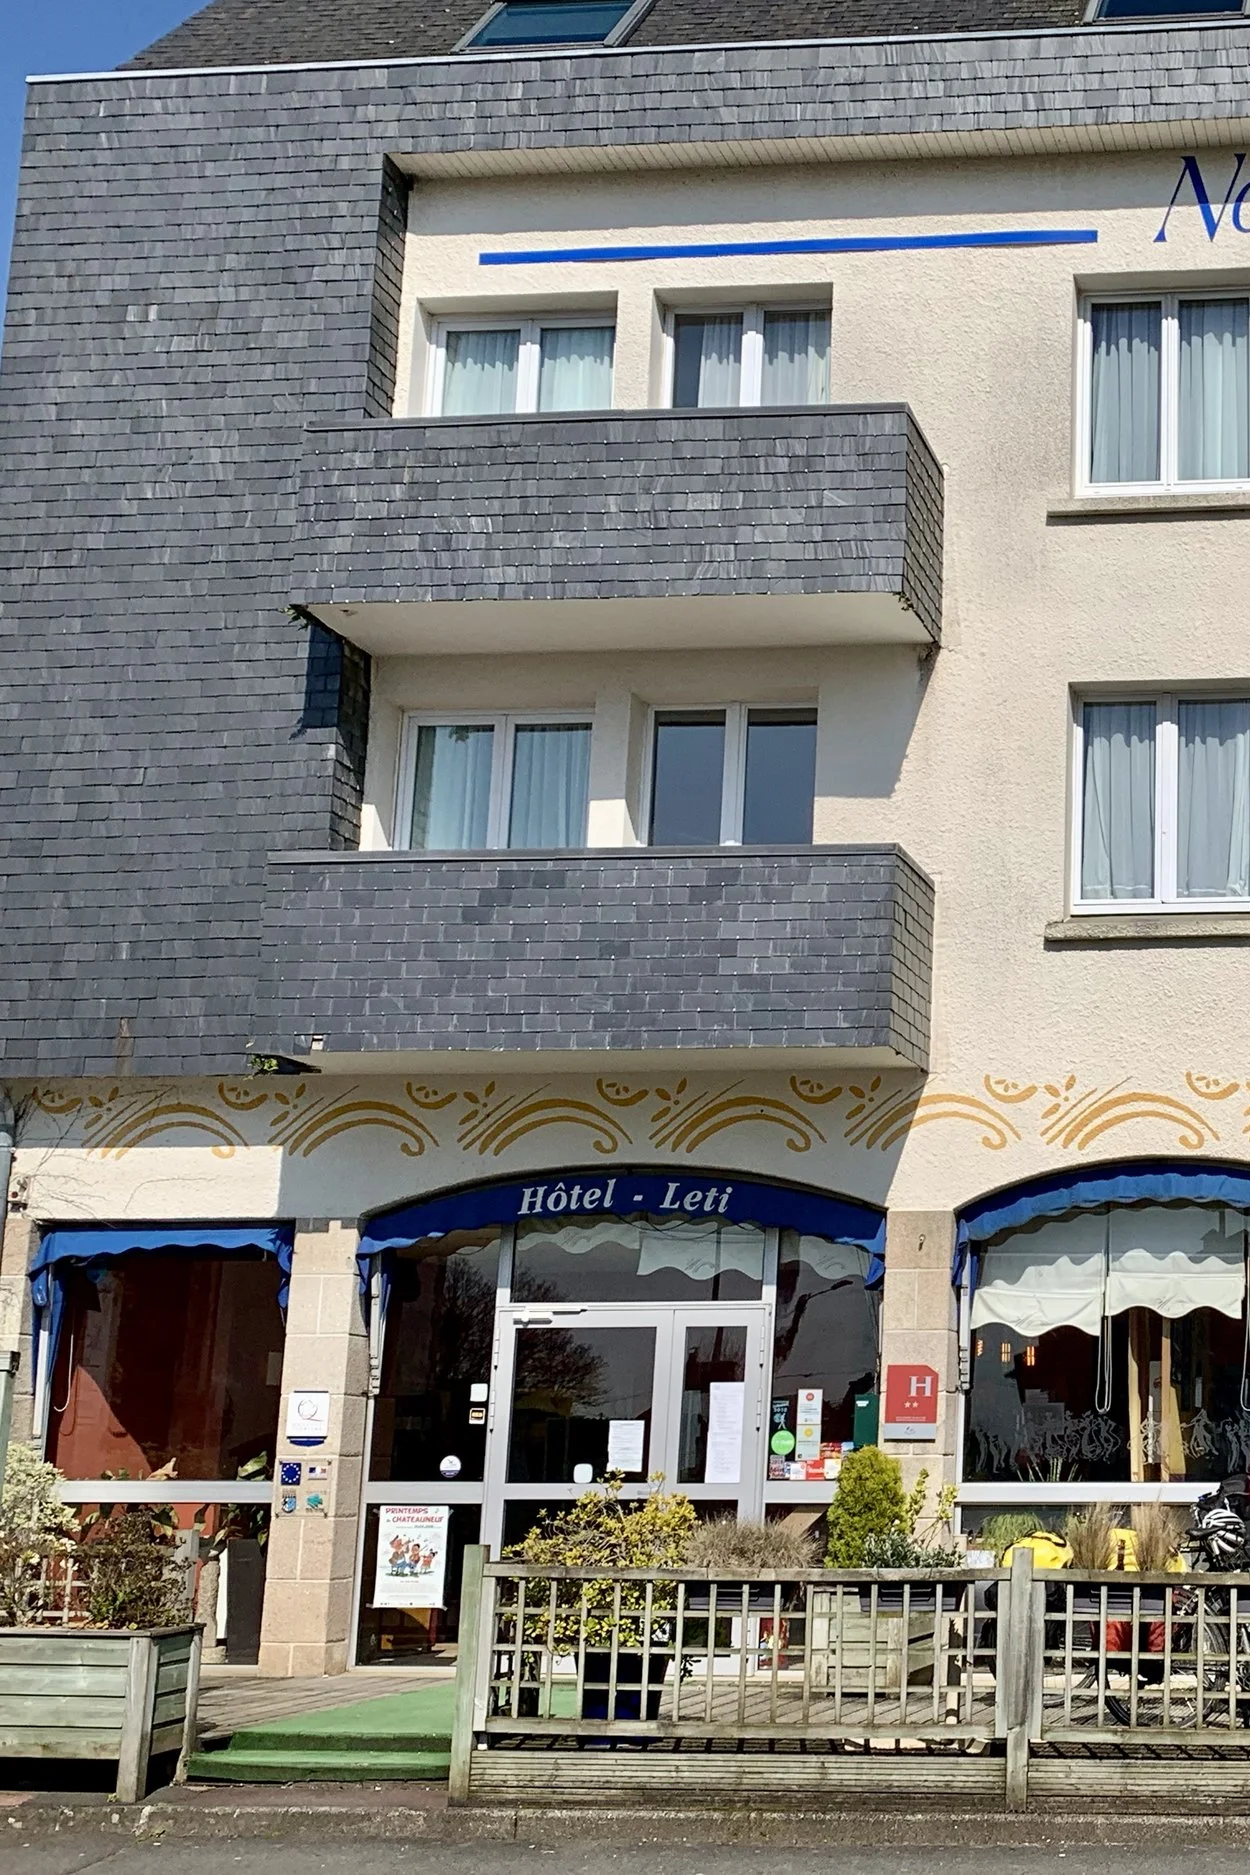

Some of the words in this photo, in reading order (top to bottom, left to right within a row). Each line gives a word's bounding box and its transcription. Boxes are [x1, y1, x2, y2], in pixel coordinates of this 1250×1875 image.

[517, 1178, 617, 1215] Hôtel
[659, 1182, 733, 1213] Leti
[908, 1375, 934, 1398] H
